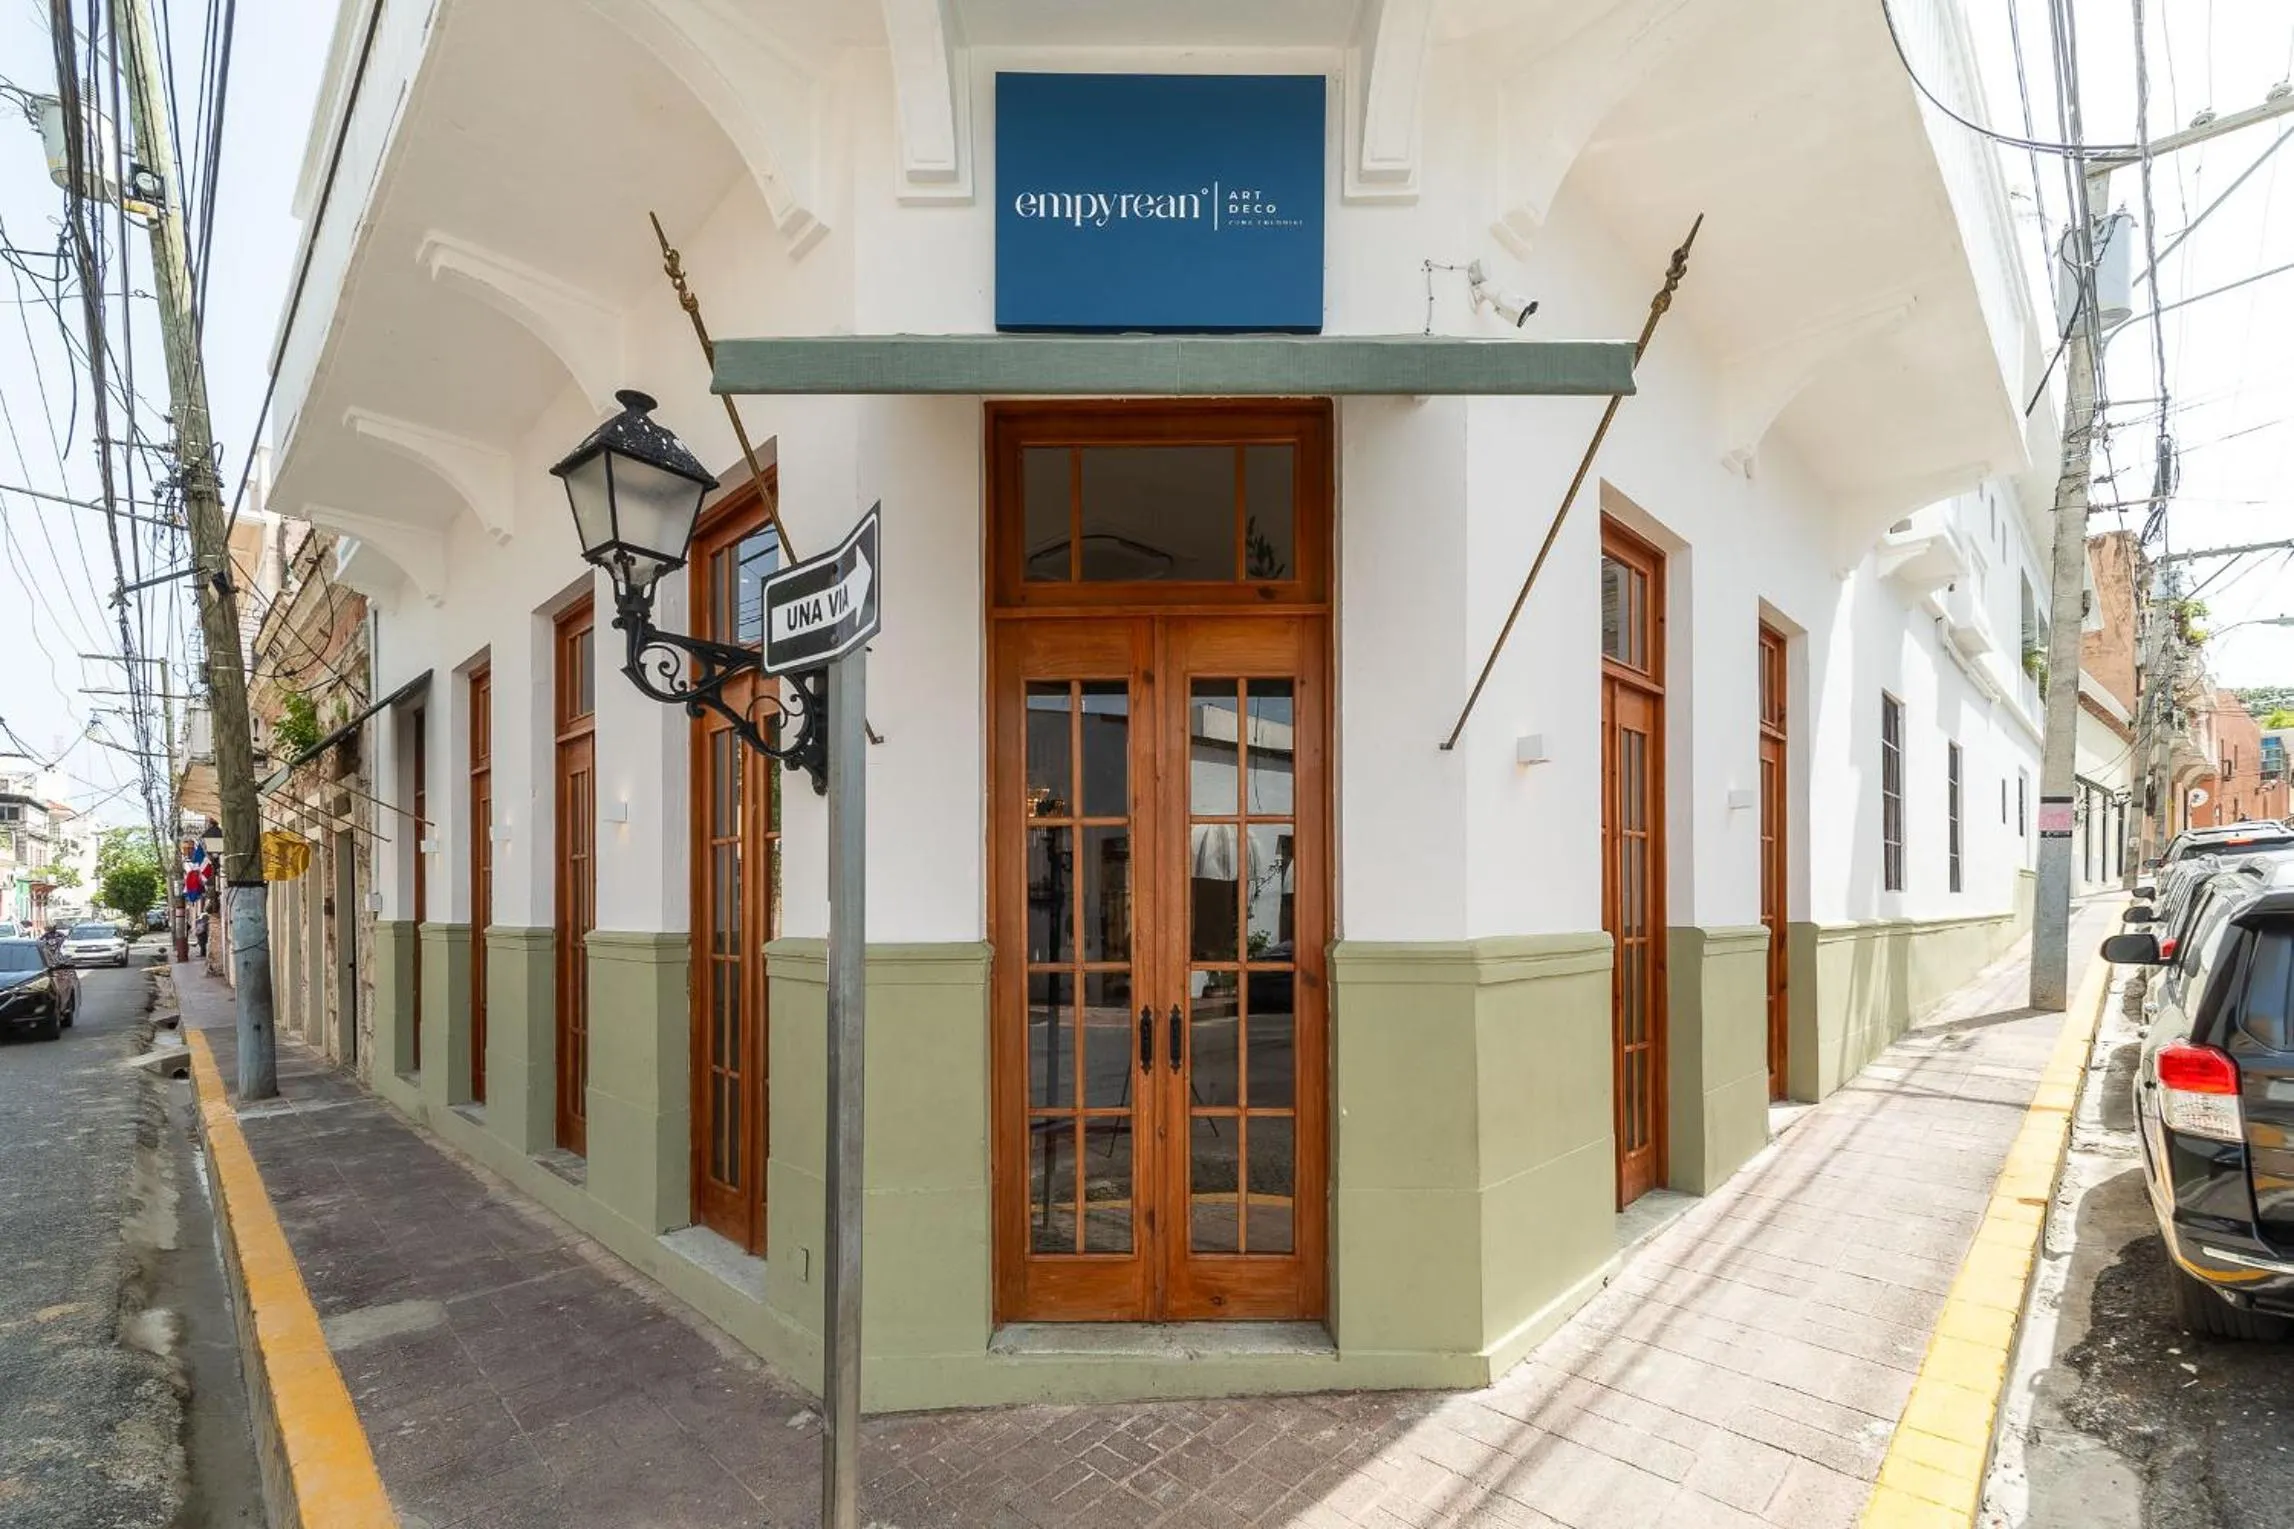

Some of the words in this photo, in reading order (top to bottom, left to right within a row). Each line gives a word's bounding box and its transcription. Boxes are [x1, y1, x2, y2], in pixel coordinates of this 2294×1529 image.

[1228, 190, 1261, 200] ART
[1228, 204, 1276, 213] DECO
[787, 598, 823, 631] UNA
[828, 583, 850, 618] VIA
